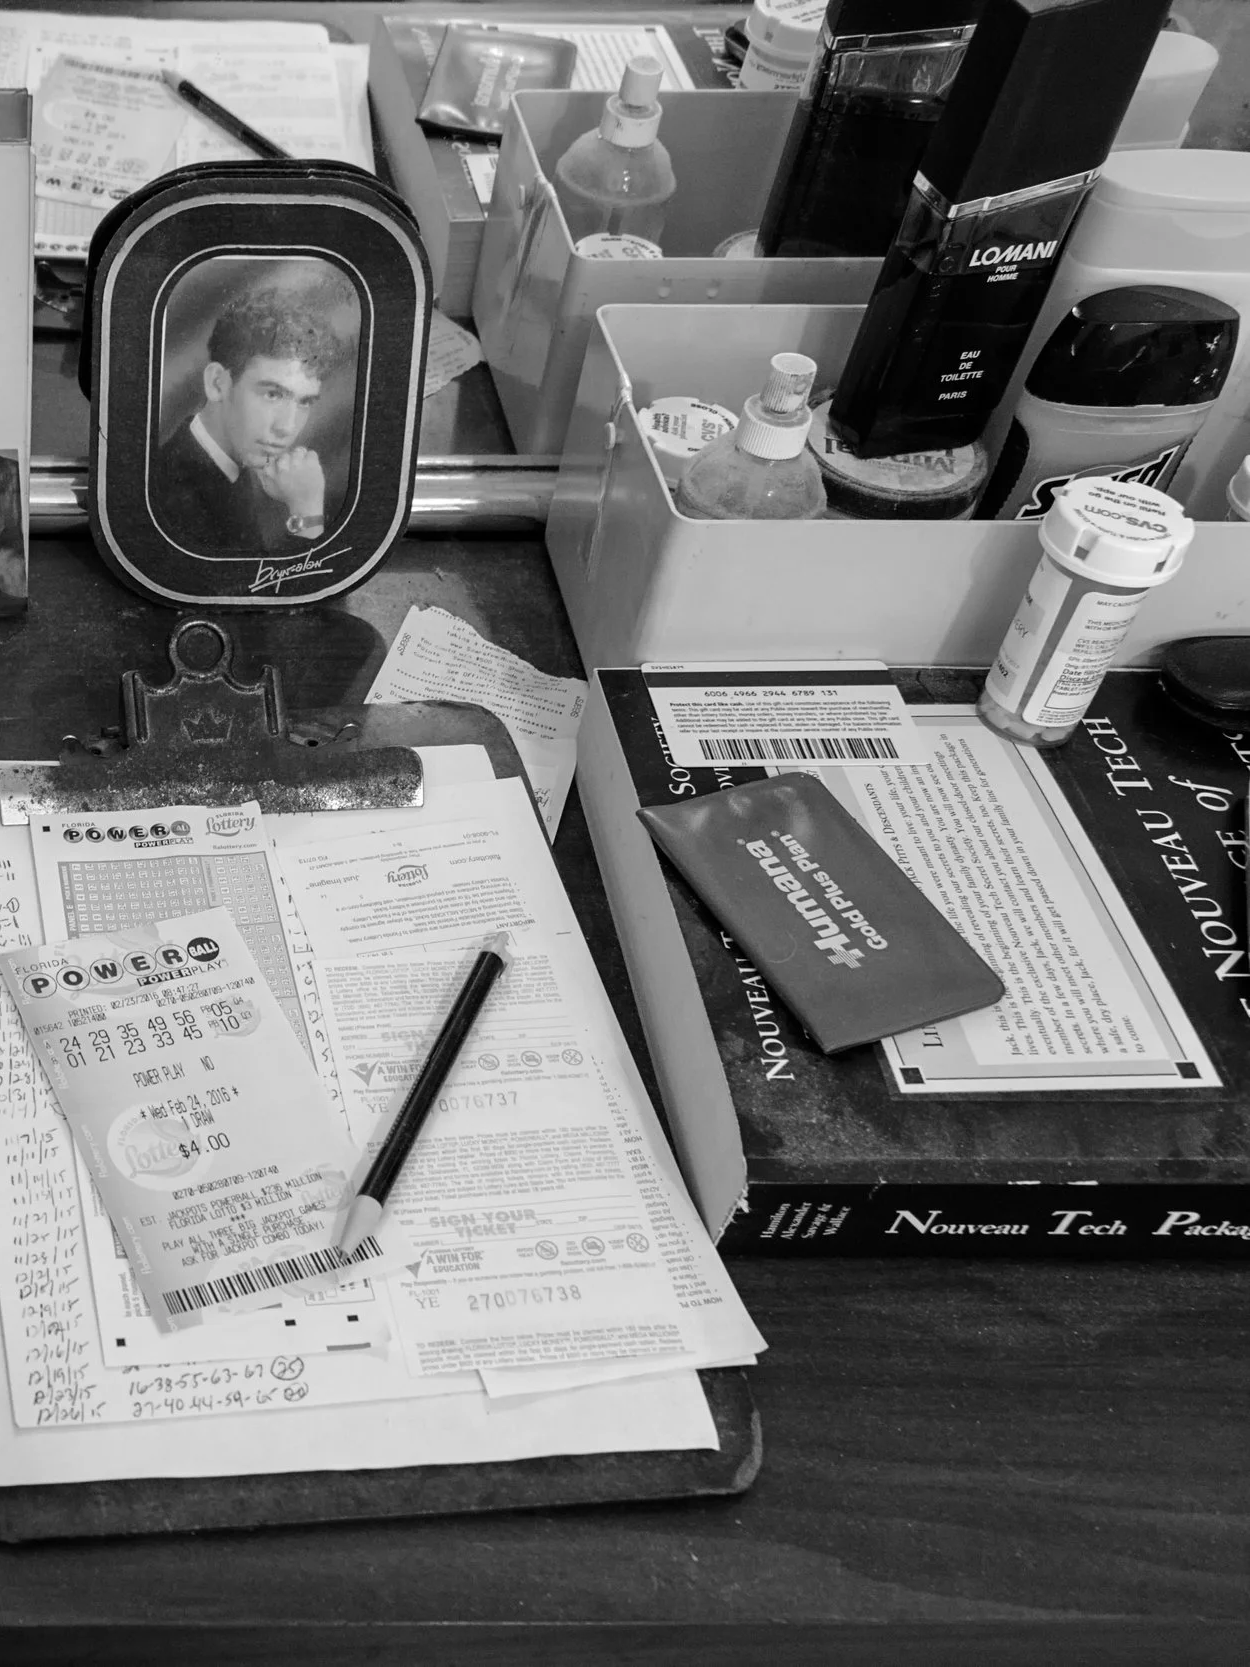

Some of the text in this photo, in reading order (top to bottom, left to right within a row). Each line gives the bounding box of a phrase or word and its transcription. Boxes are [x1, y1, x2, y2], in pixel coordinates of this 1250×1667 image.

[969, 240, 1058, 267] LOMANI
[987, 272, 1019, 283] HOMME
[995, 264, 1017, 274] POUR
[958, 361, 974, 370] DE
[959, 350, 981, 360] EAU
[940, 370, 984, 383] TOILETTE
[938, 390, 967, 401] PARIS
[701, 422, 715, 442] CVS
[1088, 491, 1102, 499] go
[1093, 486, 1160, 508] with our app.
[1104, 496, 1120, 505] the
[1139, 505, 1166, 516] Refill
[704, 690, 728, 698] 6006
[733, 690, 758, 698] 4966
[791, 689, 816, 697] 6789
[1081, 716, 1153, 797] TECH
[61, 821, 96, 829] FLORIDA
[204, 814, 256, 838] Lottery
[961, 835, 982, 864] Society.
[384, 863, 429, 885] Lottery
[975, 865, 995, 890] Secret
[811, 870, 853, 911] Plus
[987, 891, 1005, 911] Tech
[1136, 808, 1250, 981] NOUVEAU
[746, 838, 866, 969] Humana
[848, 908, 888, 951] Gold
[1000, 912, 1024, 949] Nouveau
[13, 957, 69, 976] FLORIDA
[1018, 950, 1044, 989] exclusive
[67, 1003, 108, 1019] PRINTED:
[59, 1009, 196, 1054] 24 29 35 49 56
[1051, 1018, 1075, 1055] member
[66, 1023, 203, 1069] 01 21 23 33 45
[132, 1055, 215, 1088] POWER PLAY NO
[148, 1103, 169, 1120] Wed
[166, 1099, 188, 1116] Feb
[206, 1086, 231, 1106] 2016
[190, 1108, 215, 1128] DRAW
[178, 1132, 231, 1160] $4.00
[429, 1208, 538, 1229] SIGN YOUR
[760, 1203, 791, 1238] Hamilton
[780, 1201, 812, 1240] Alexander
[822, 1206, 852, 1236] Wallace
[885, 1210, 1030, 1235] Nouveau
[1047, 1210, 1128, 1236] Tech
[454, 1222, 517, 1239] TICKET
[426, 1251, 483, 1265] A WIN FOR
[433, 1262, 481, 1274] EDUCATION
[416, 1297, 440, 1310] YE
